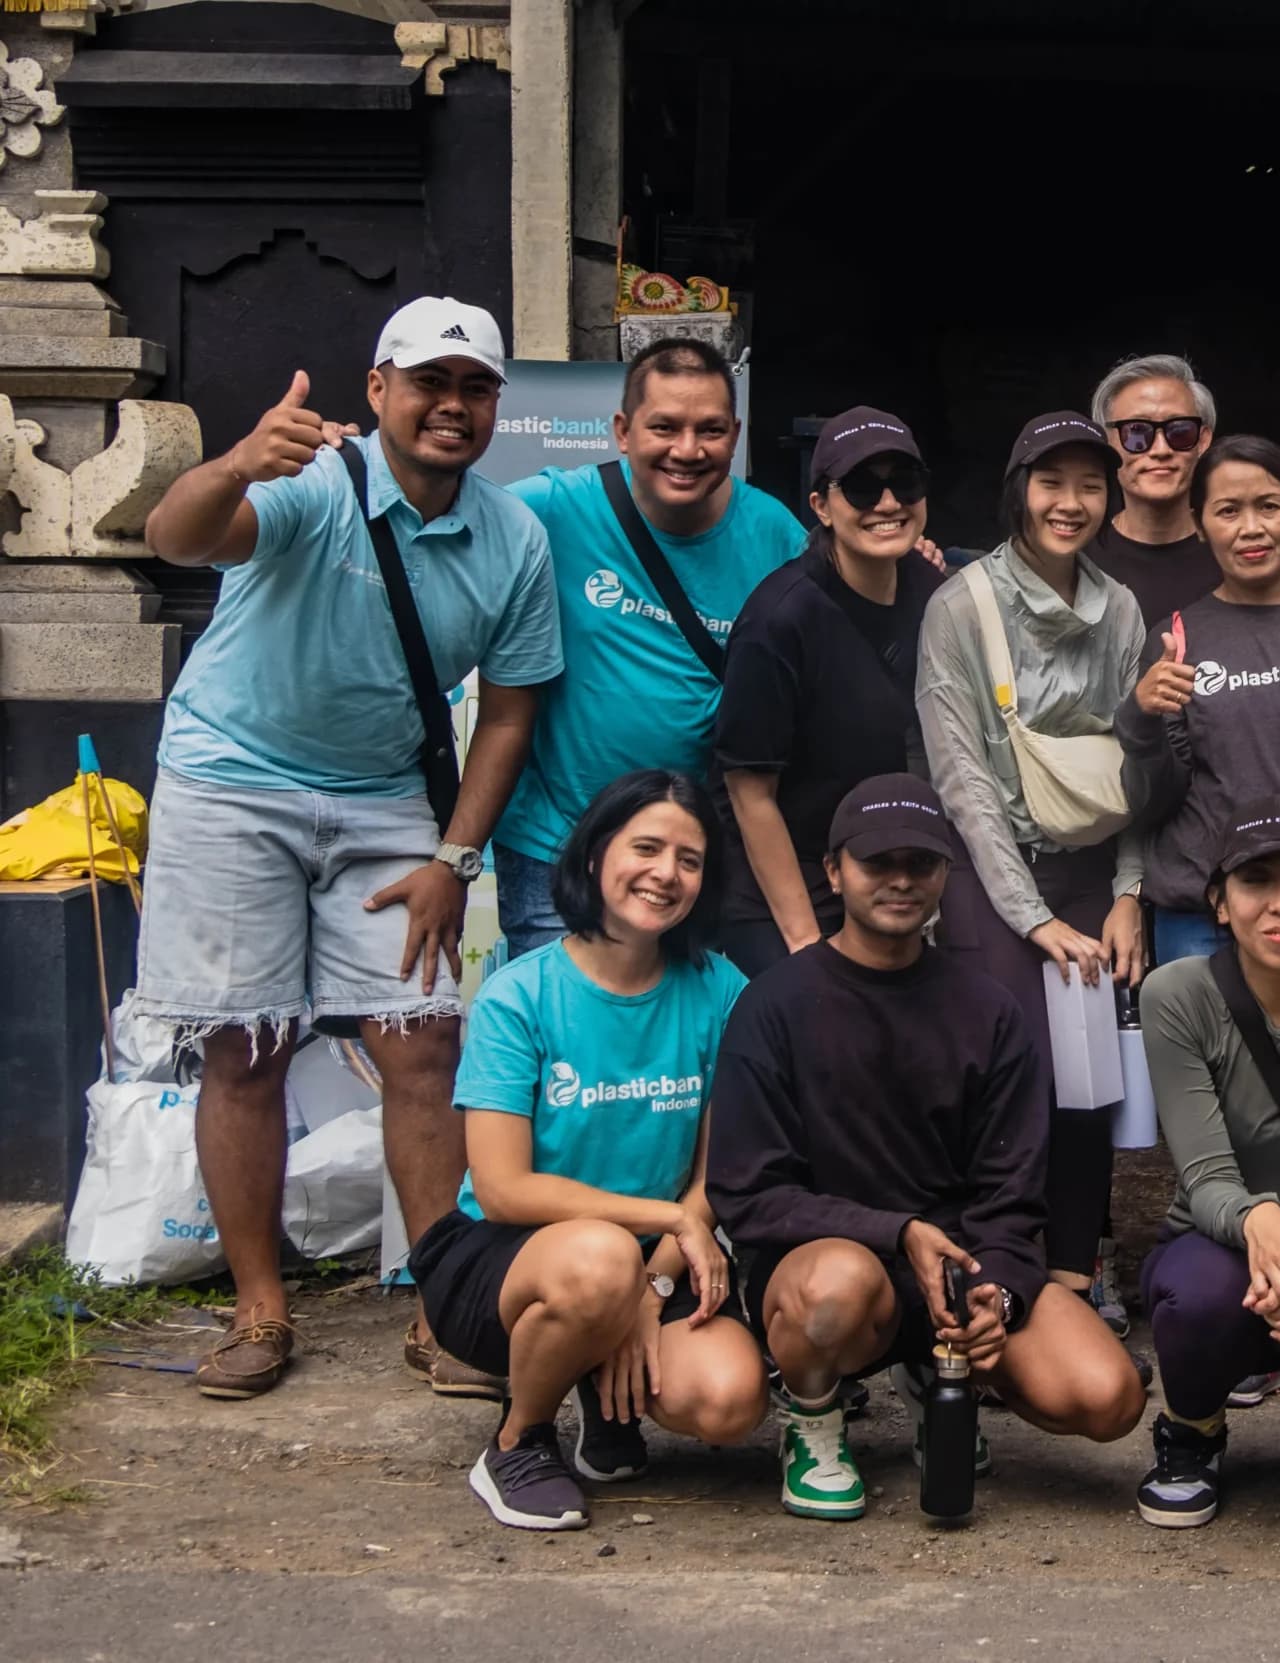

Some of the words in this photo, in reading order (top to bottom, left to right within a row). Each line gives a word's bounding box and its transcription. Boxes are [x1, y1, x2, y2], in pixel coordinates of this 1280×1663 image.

[495, 416, 608, 435] asticbank
[543, 437, 609, 450] Indonesia
[581, 1074, 704, 1109] plasticban
[651, 1097, 701, 1113] Indone
